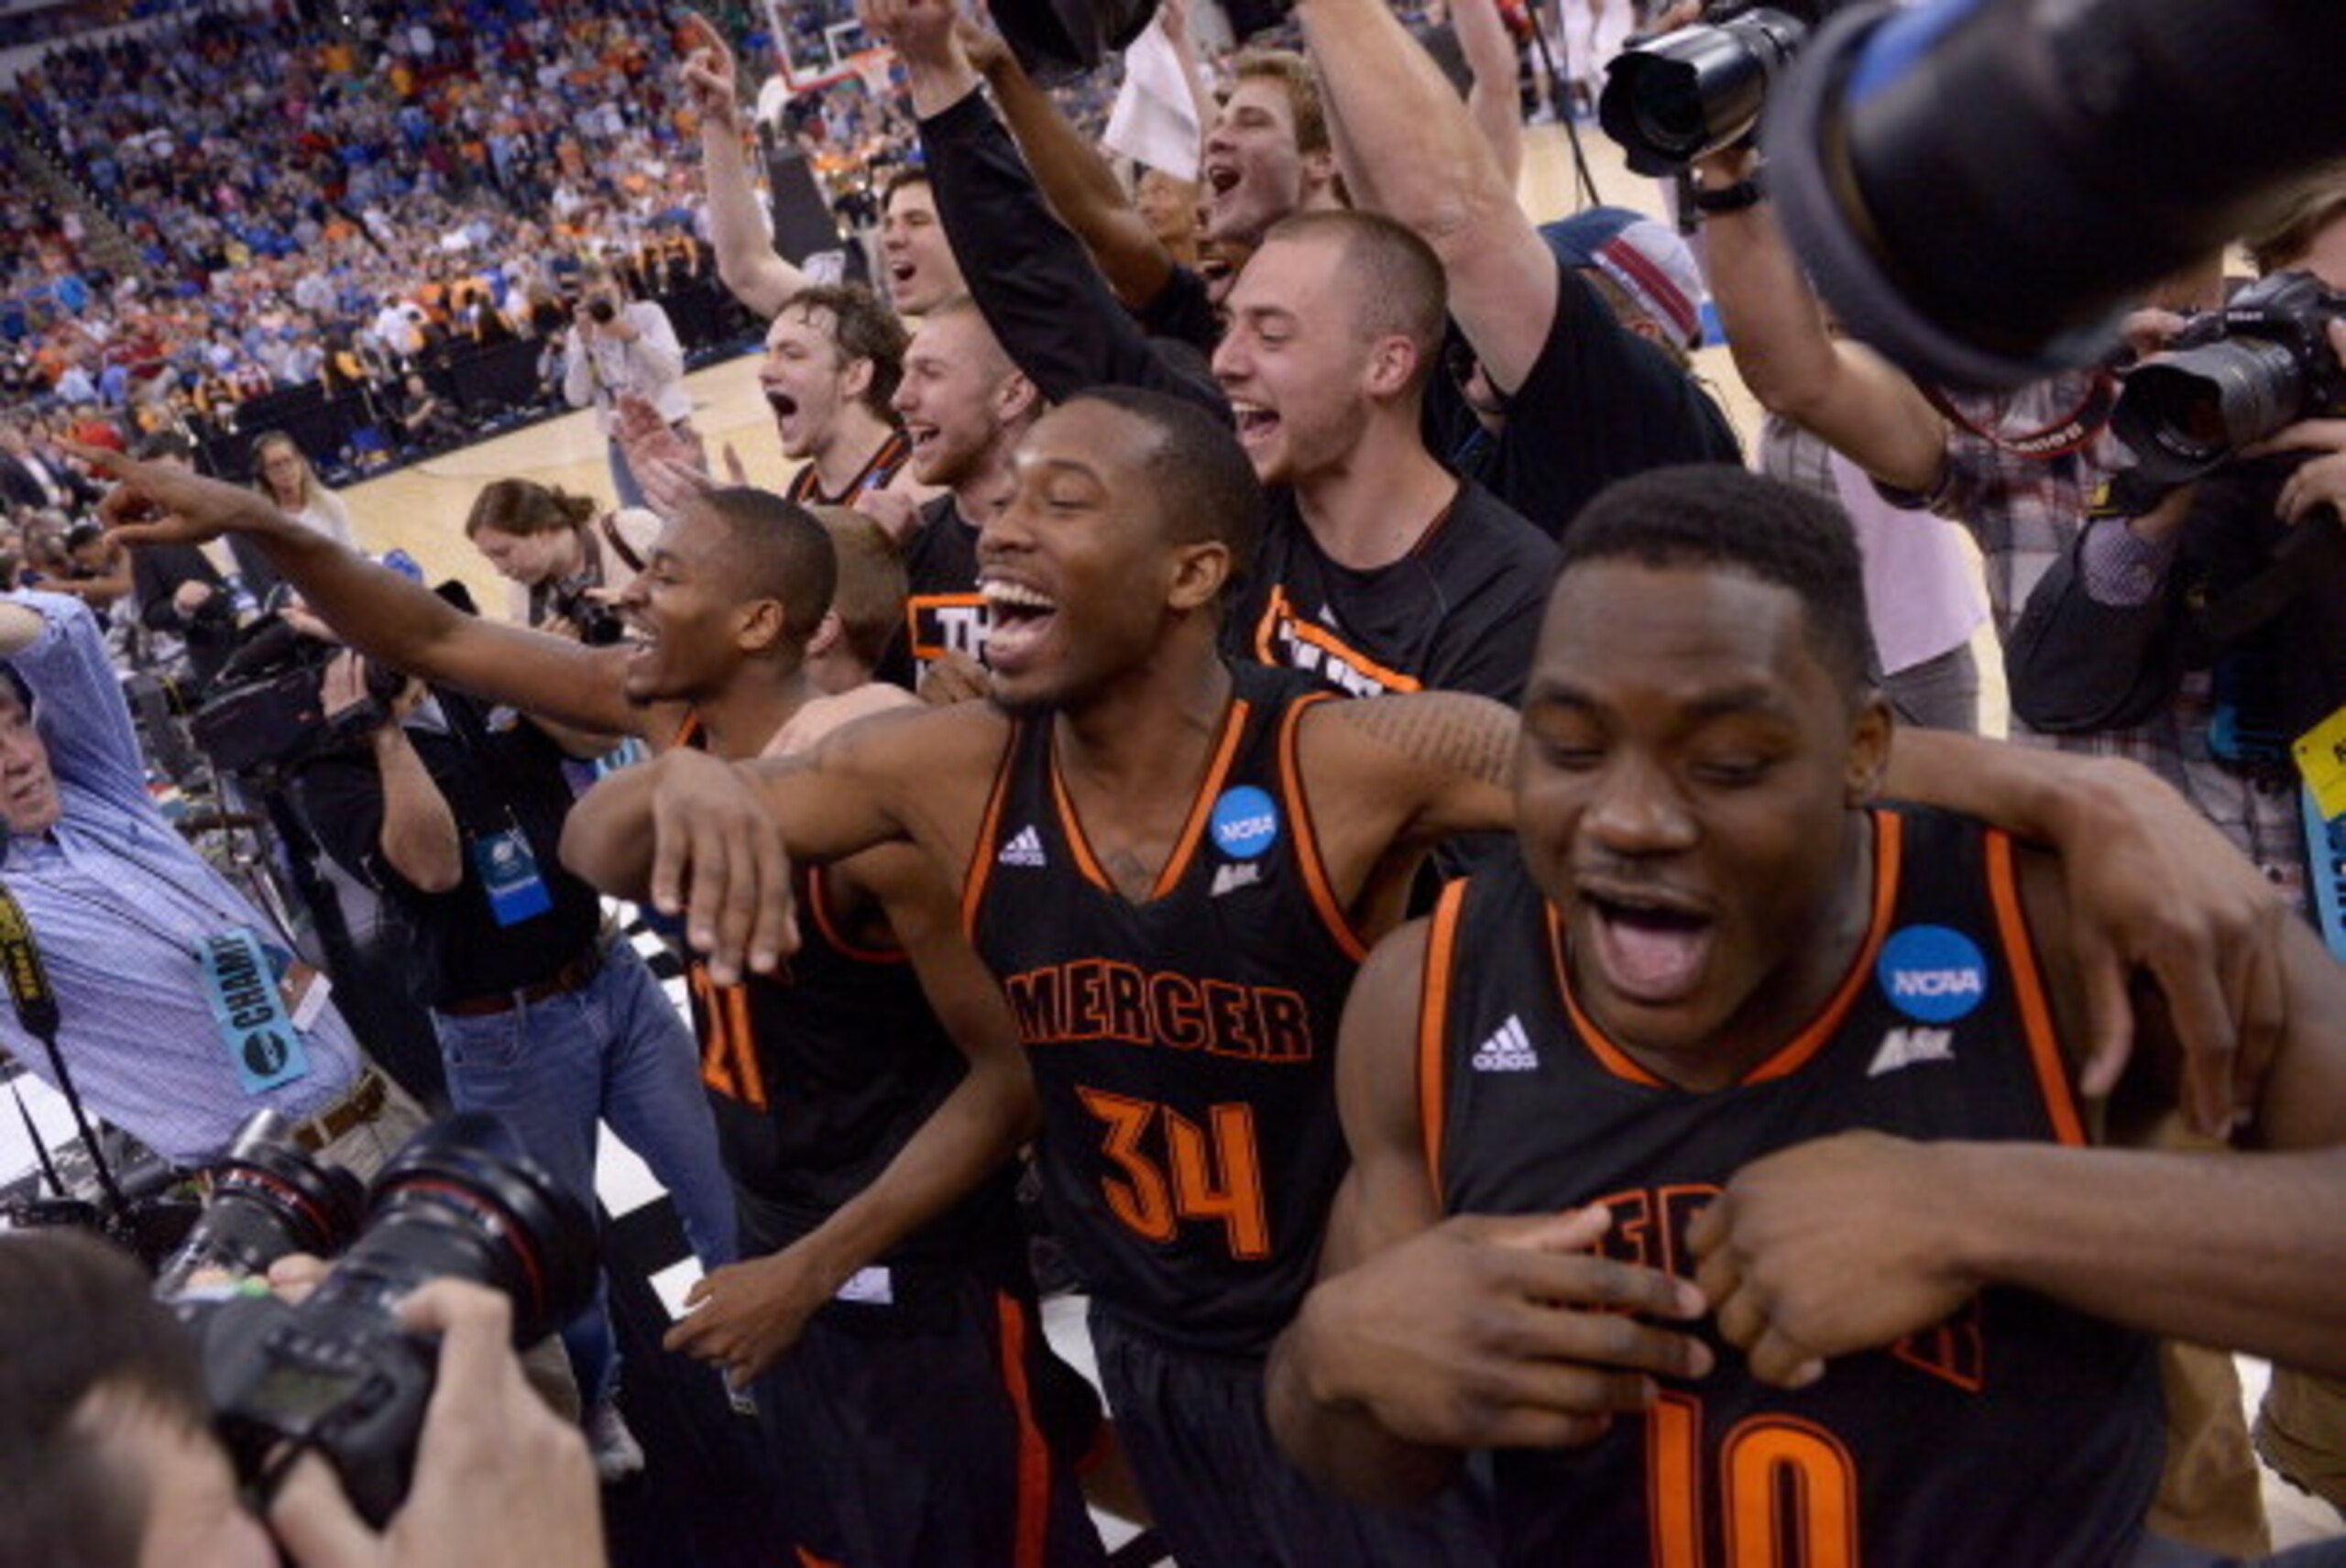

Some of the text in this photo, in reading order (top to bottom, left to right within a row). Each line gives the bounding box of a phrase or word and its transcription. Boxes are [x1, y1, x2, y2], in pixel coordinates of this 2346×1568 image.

[936, 607, 992, 660] TH
[1219, 814, 1276, 842] NCAA
[1894, 968, 1981, 996] NCAA
[1006, 957, 1313, 1063] MERCER
[1472, 1049, 1539, 1071] adidas
[1074, 1085, 1269, 1261] 34
[1647, 1389, 1858, 1568] 10
